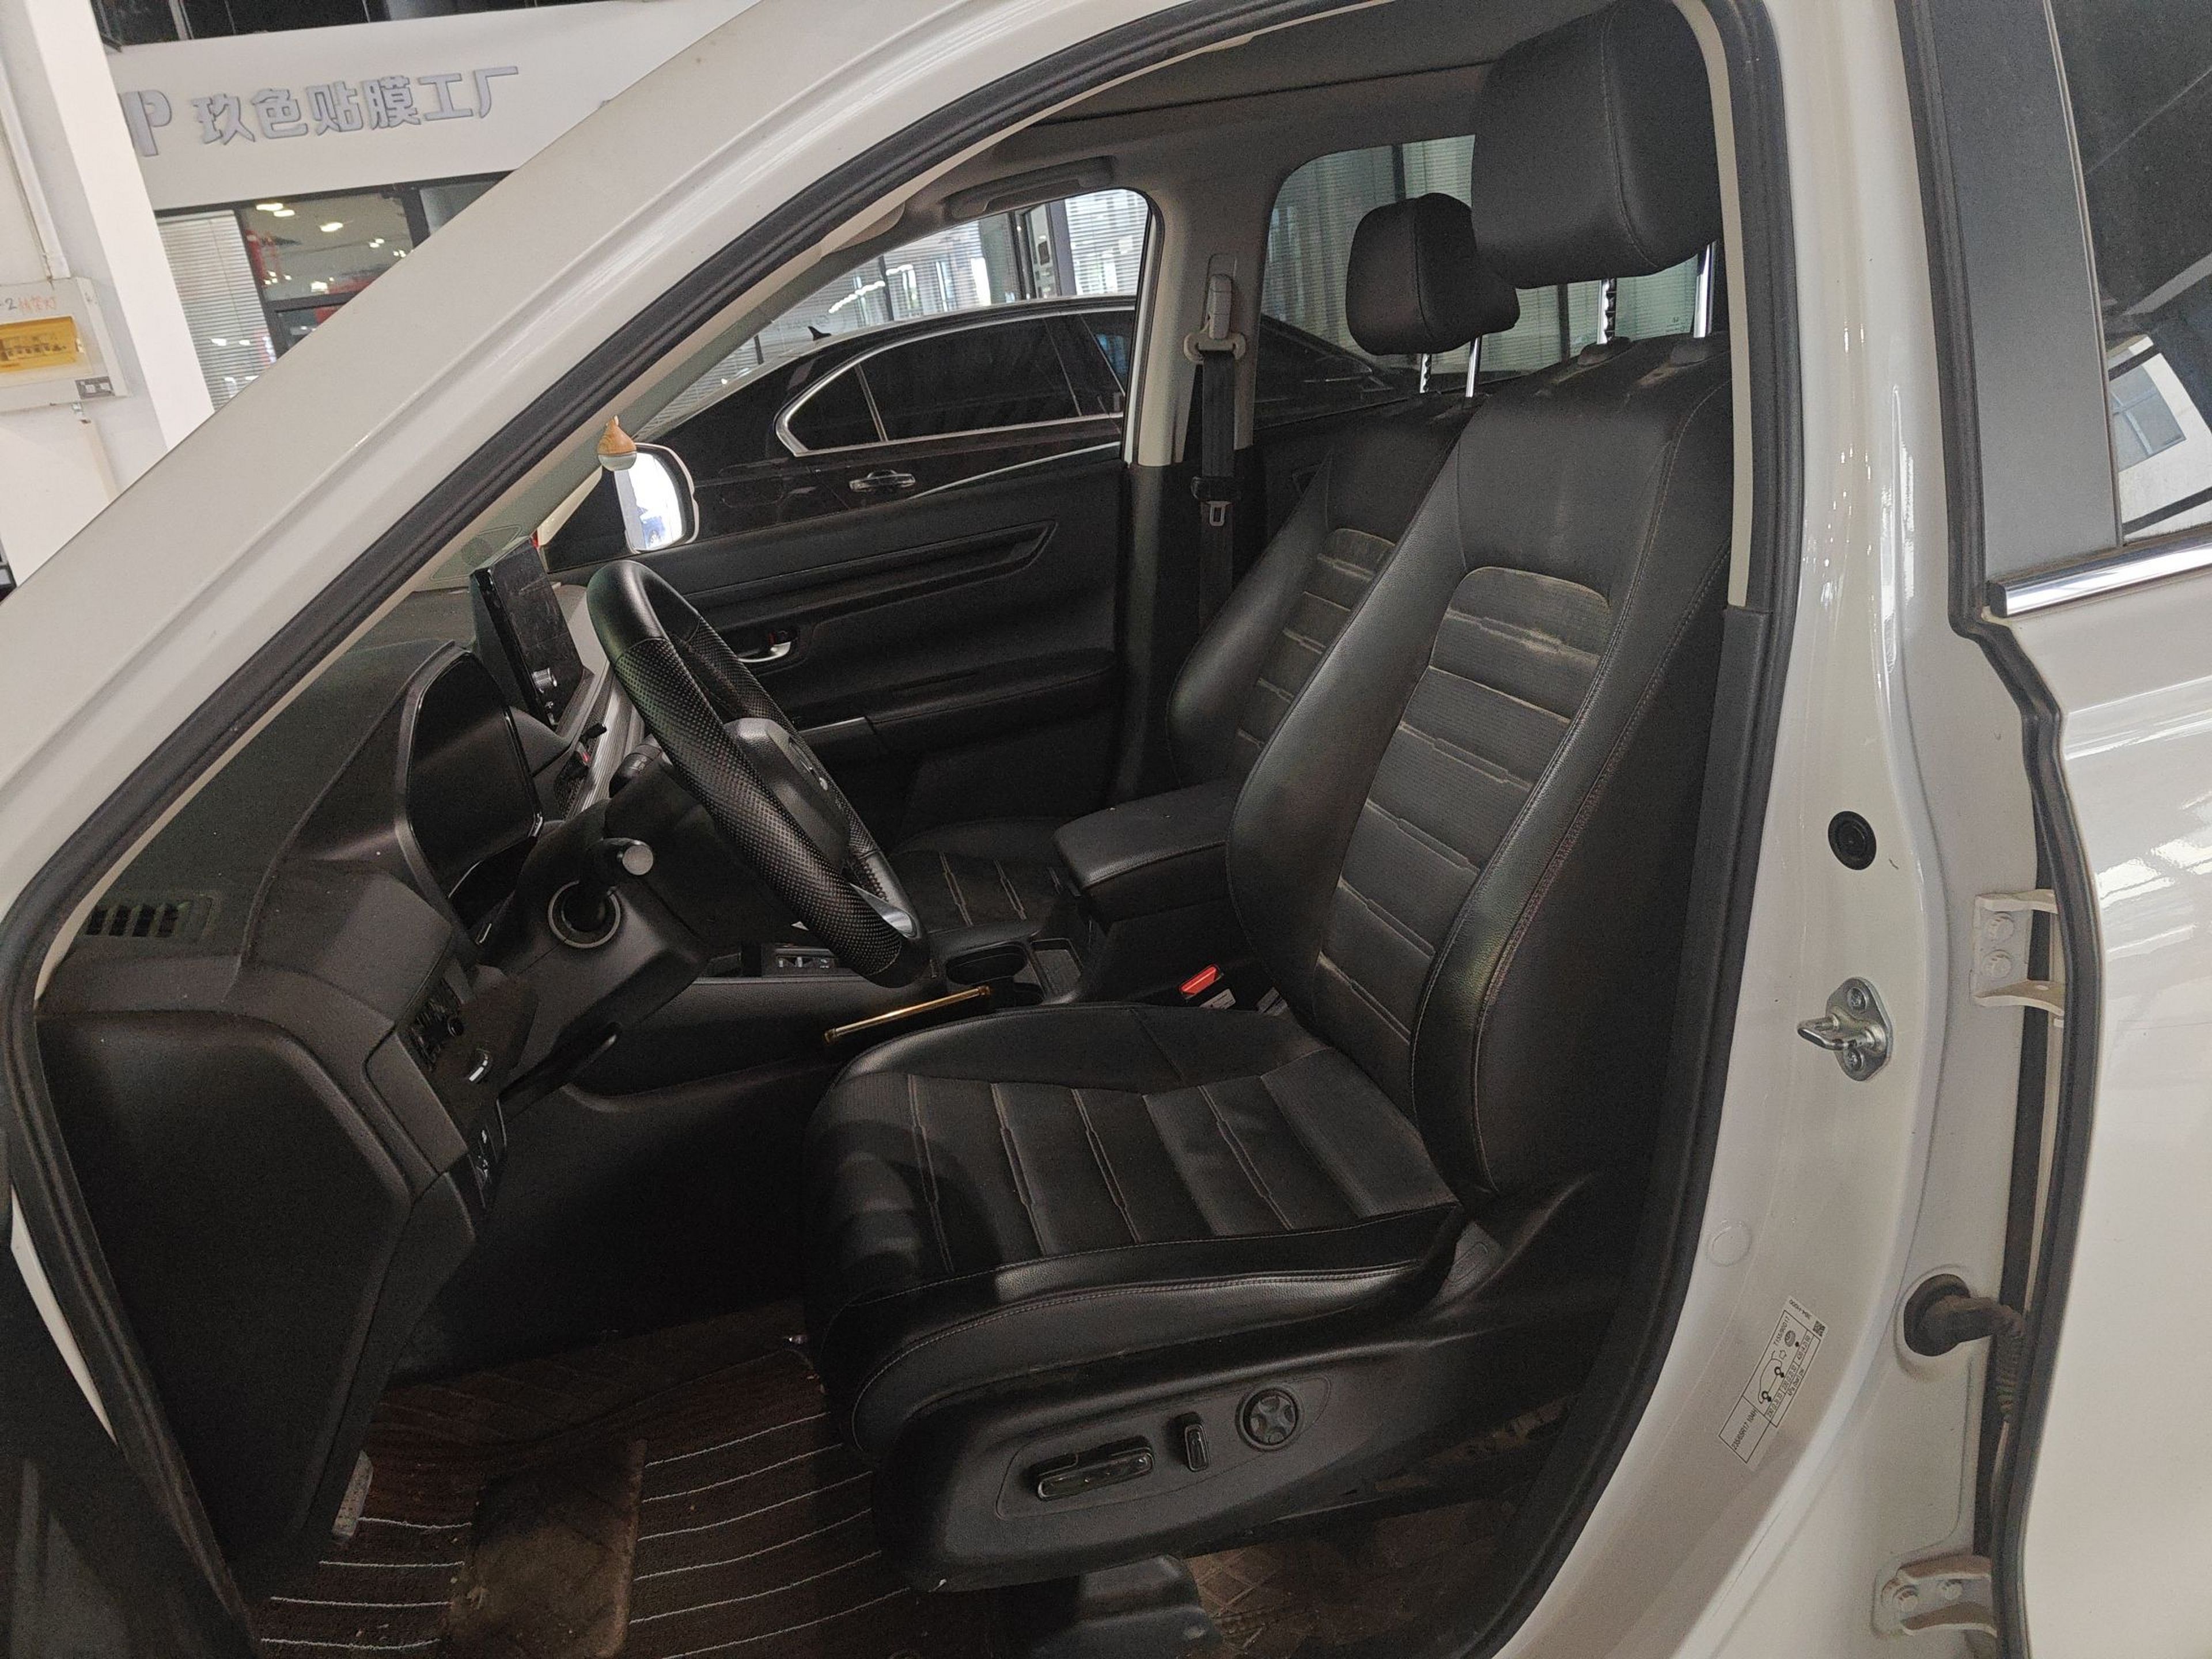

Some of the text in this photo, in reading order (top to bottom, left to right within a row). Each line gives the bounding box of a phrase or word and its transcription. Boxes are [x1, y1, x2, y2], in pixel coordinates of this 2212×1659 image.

[191, 66, 520, 146] 玖色贴膜工厂
